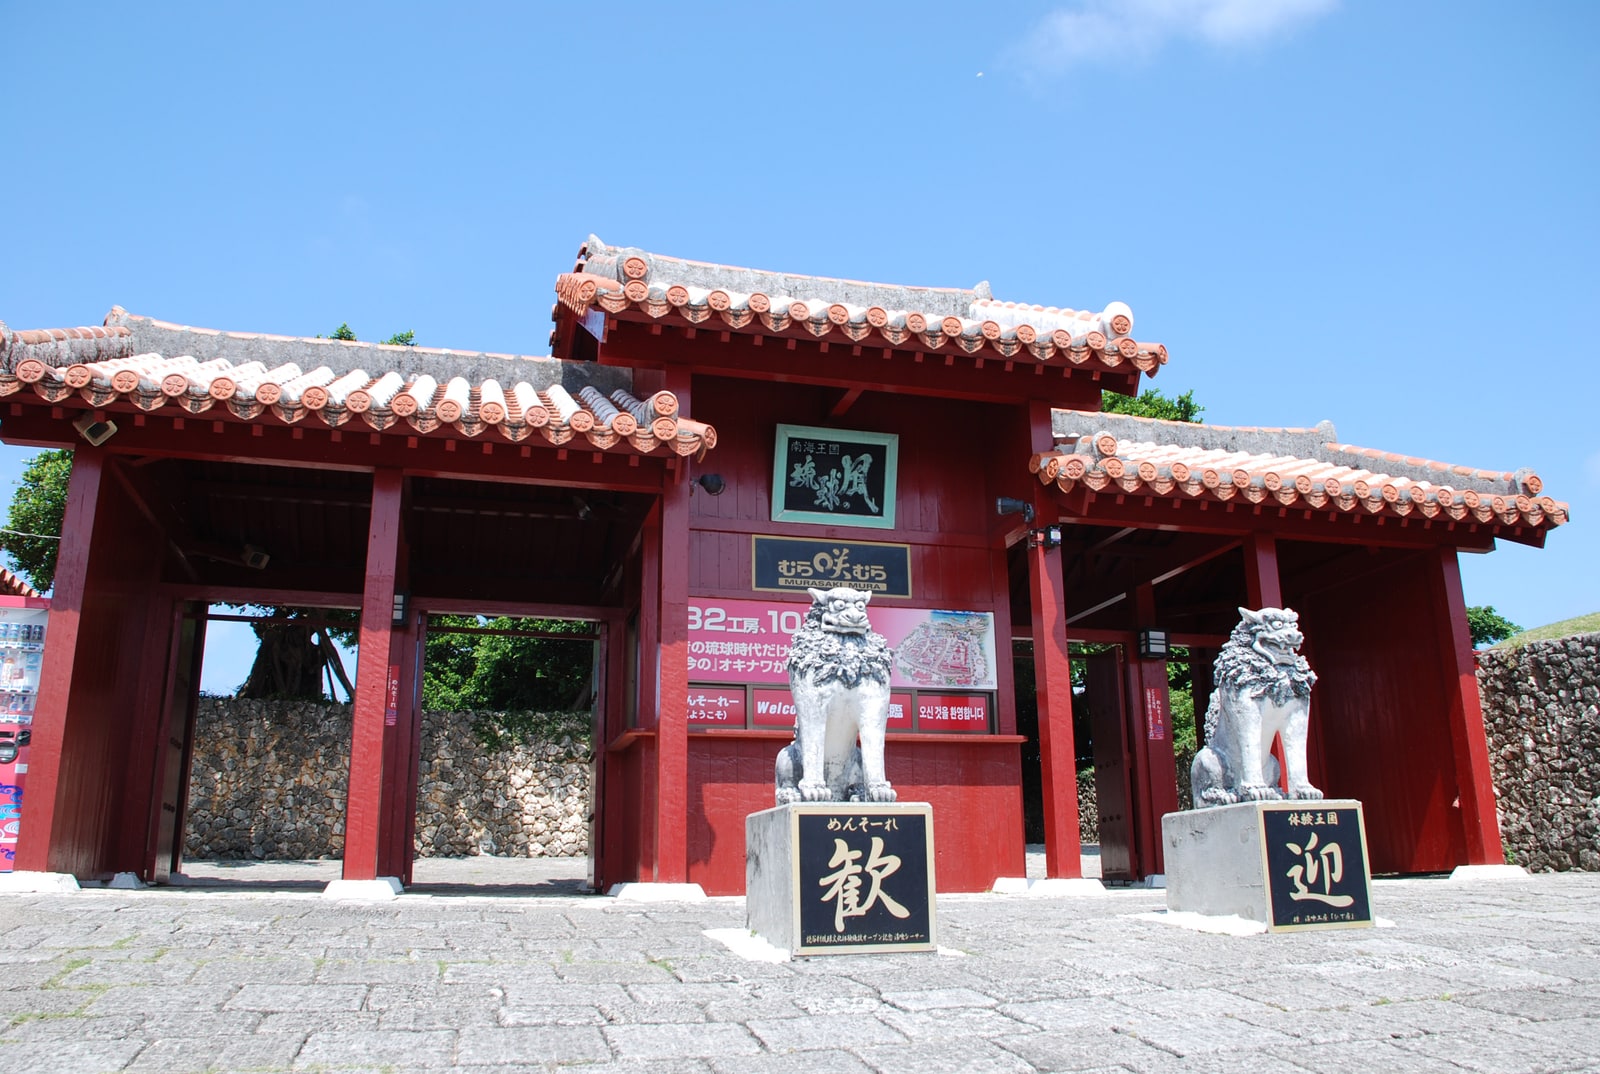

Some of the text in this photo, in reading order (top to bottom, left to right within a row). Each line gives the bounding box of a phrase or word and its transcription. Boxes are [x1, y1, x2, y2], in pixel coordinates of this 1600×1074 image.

[777, 548, 888, 581] むら咲むら
[784, 578, 881, 590] MURASAKI MURA
[687, 641, 791, 657] の琉球時代だけ
[887, 703, 904, 719] 臨
[826, 817, 899, 832] めんそーれ
[1287, 811, 1339, 826] 体験王国
[1286, 832, 1354, 907] 迎
[819, 837, 910, 932] 歓
